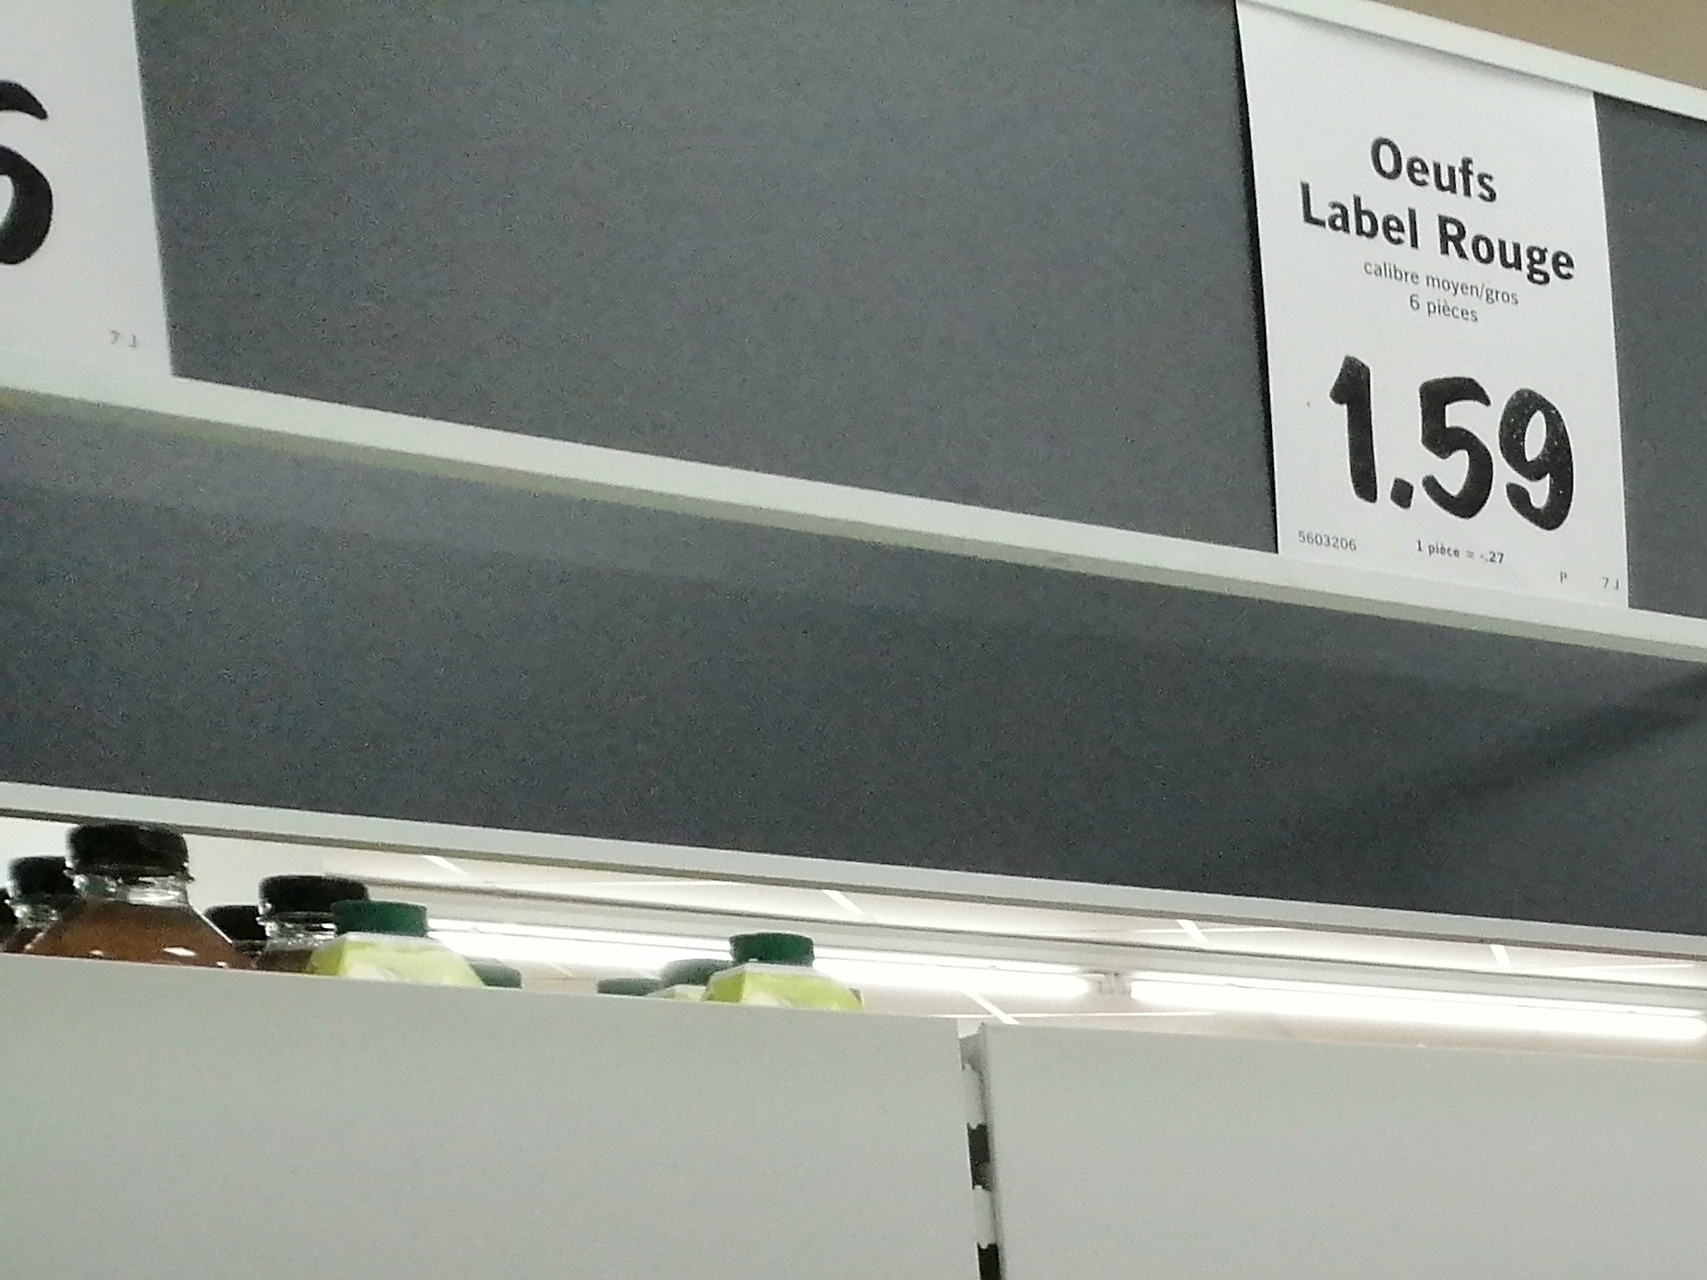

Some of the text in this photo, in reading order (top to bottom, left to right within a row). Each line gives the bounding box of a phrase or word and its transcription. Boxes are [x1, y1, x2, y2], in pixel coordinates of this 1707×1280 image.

[1371, 137, 1497, 202] Oeufs
[1300, 181, 1575, 285] Label Rouge
[1364, 260, 1519, 306] calibre moyen/gros
[1409, 294, 1478, 325] 6 pièces
[1329, 355, 1574, 531] 1.59
[1428, 541, 1461, 559] pièce
